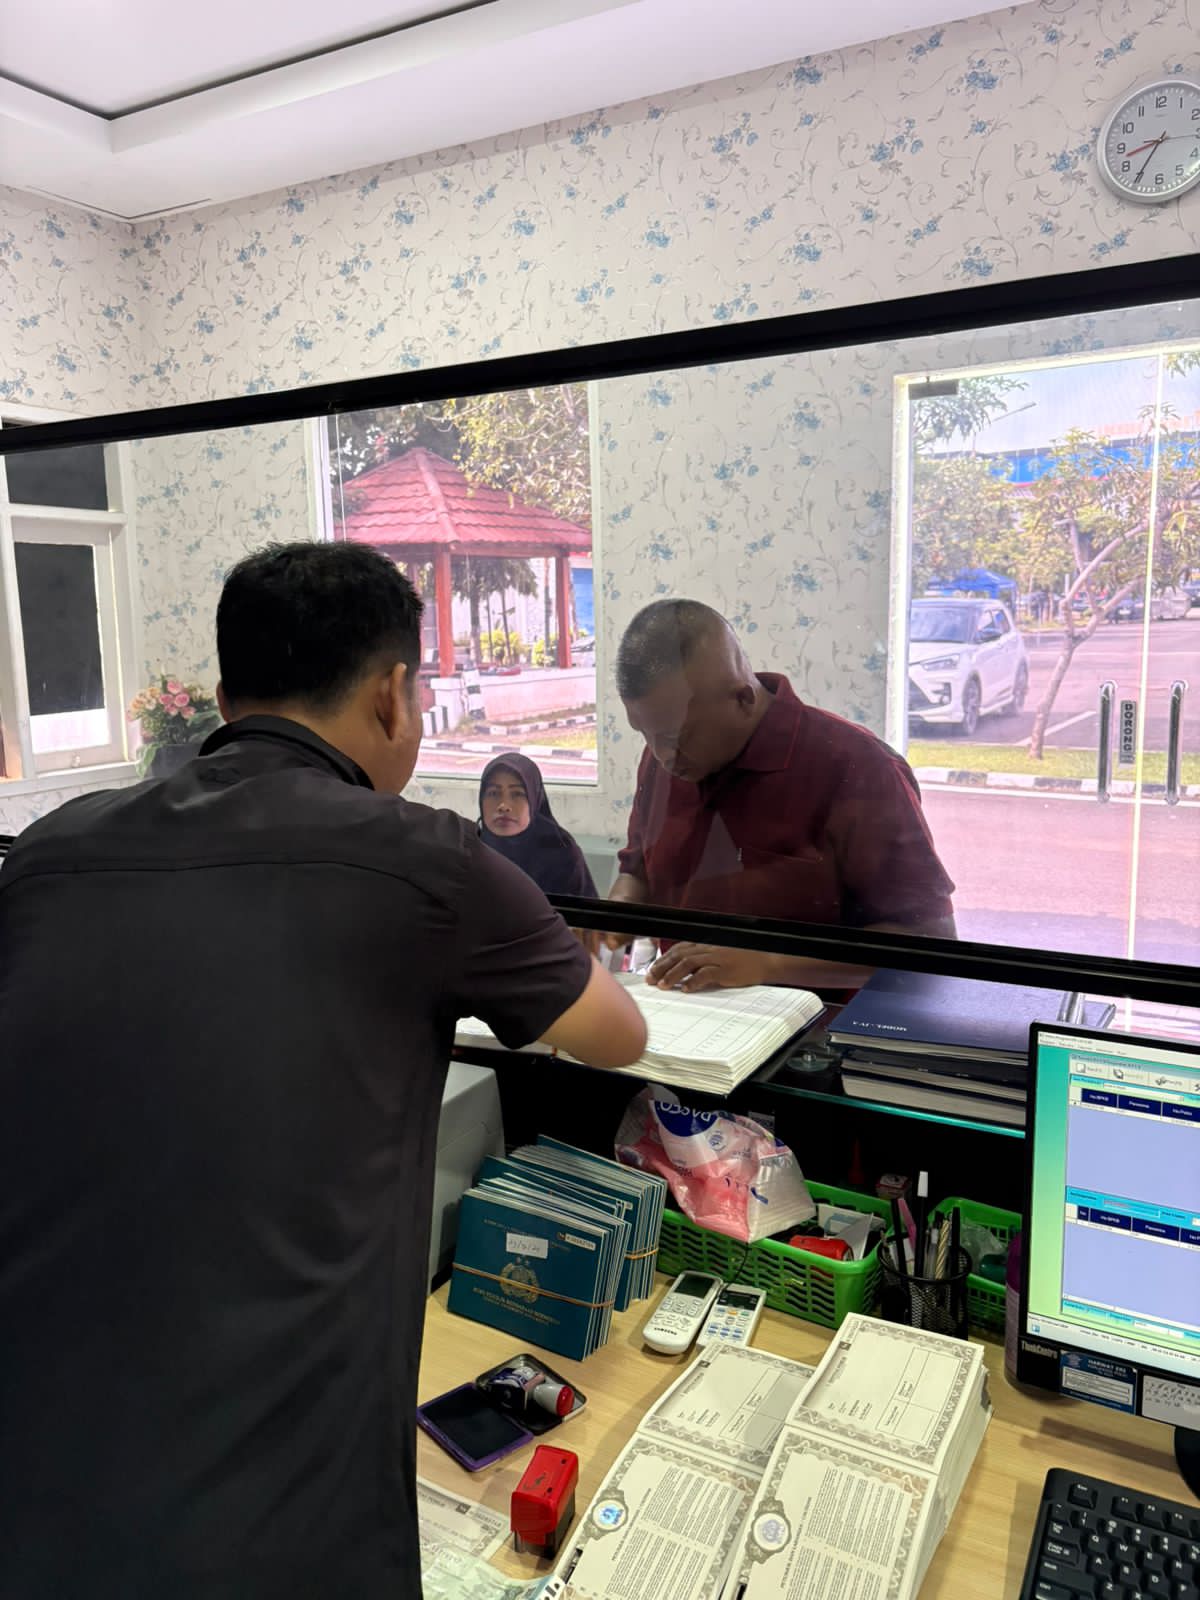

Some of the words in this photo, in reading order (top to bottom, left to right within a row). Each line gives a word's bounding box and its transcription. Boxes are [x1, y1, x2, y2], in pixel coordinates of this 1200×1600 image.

[1155, 96, 1167, 109] 12
[1138, 106, 1145, 117] 11
[1191, 108, 1200, 121] 2
[1122, 122, 1134, 135] 10
[1117, 142, 1126, 154] 9
[1190, 147, 1198, 158] 4
[1121, 160, 1131, 173] 8
[1175, 164, 1184, 176] 5
[1154, 173, 1164, 185] 6
[1124, 703, 1133, 752] DORONG
[654, 1327, 677, 1335] SAMSUNG
